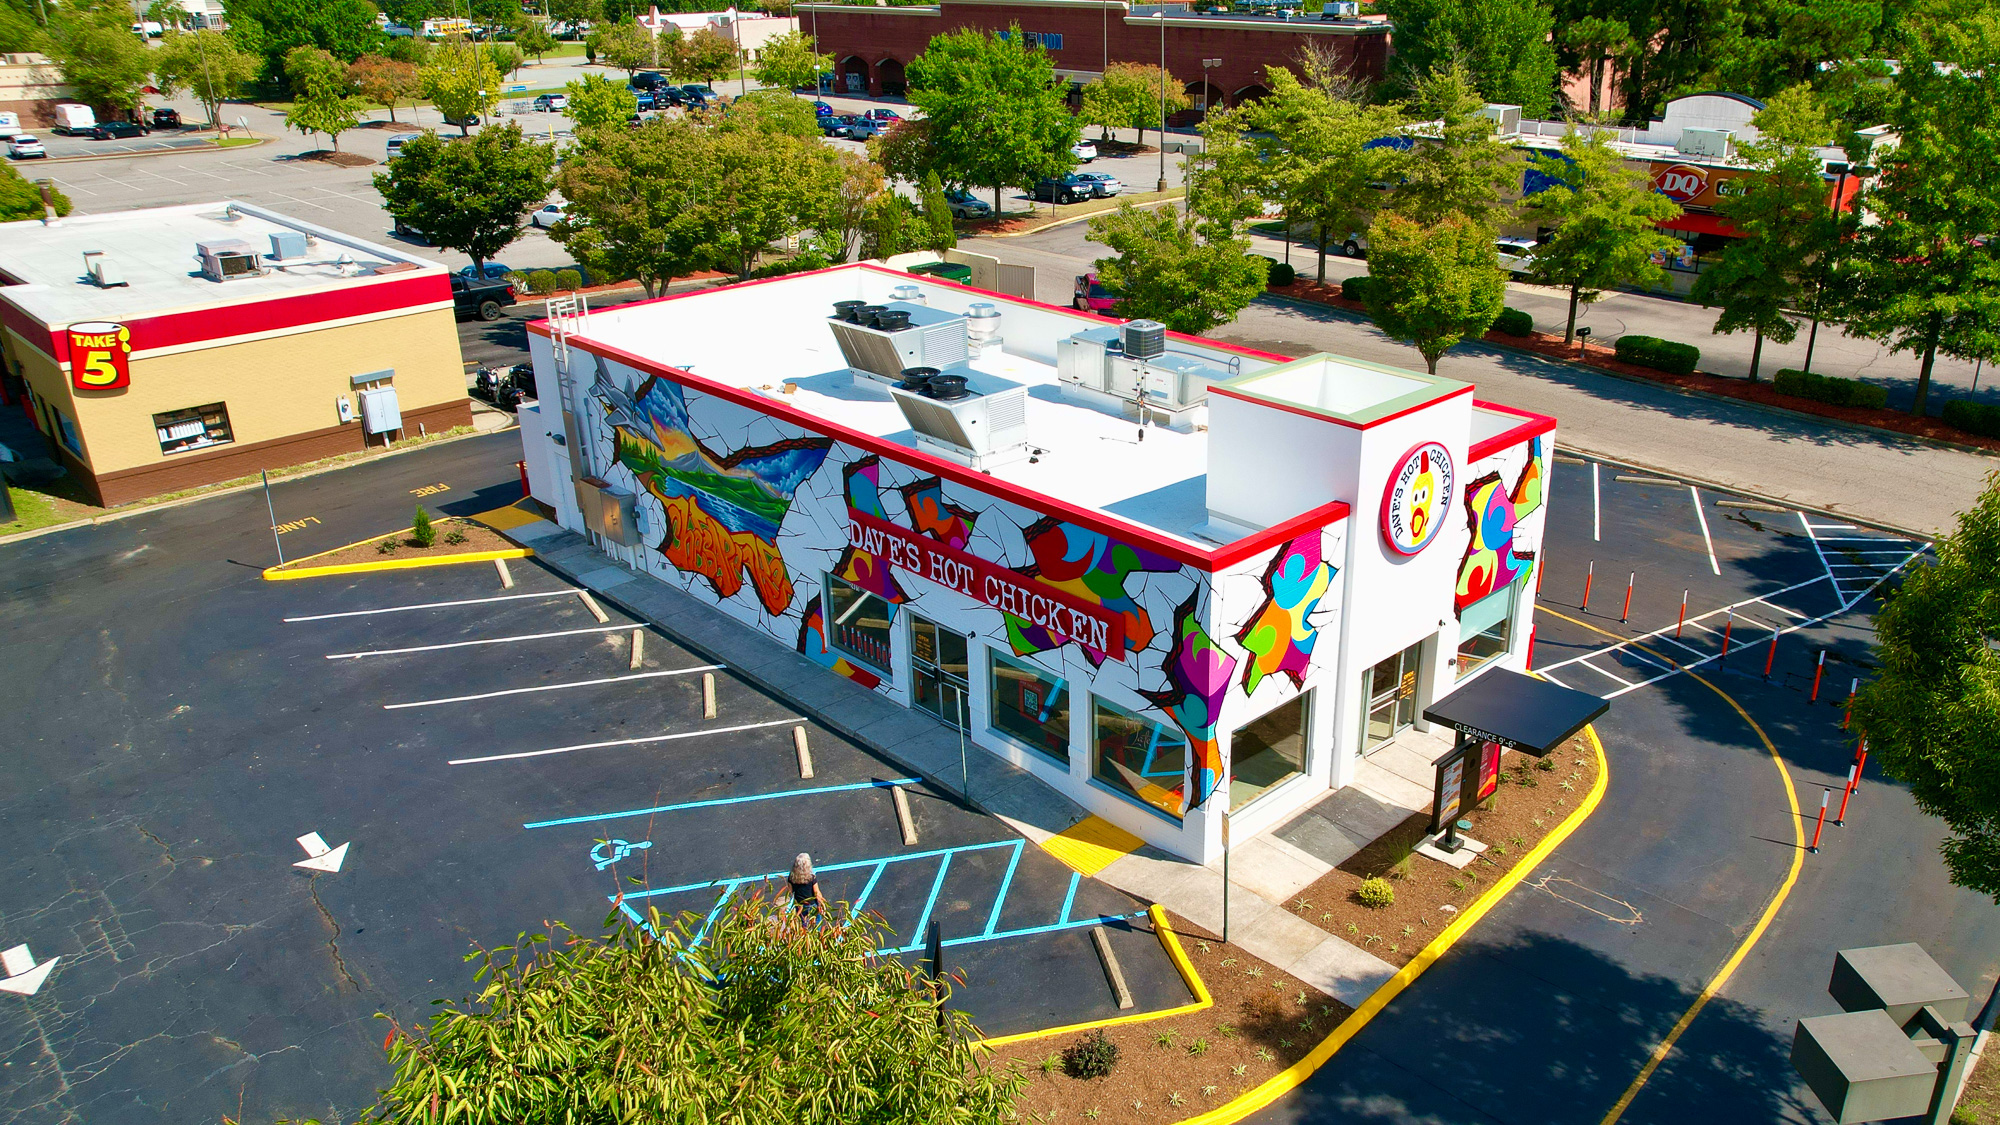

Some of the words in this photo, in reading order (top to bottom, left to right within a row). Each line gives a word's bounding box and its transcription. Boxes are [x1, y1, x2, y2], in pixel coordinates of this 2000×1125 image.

[1663, 173, 1699, 195] DQ
[71, 334, 116, 348] TAKE
[82, 351, 118, 385] 5
[409, 482, 451, 498] FIRE
[1392, 487, 1404, 539] DAVE'S
[1401, 456, 1420, 485] HOT
[1429, 449, 1450, 506] CHICKEN
[270, 516, 321, 535] LANE
[848, 518, 921, 573] DAVE'S
[927, 550, 974, 596] HOT
[985, 575, 1109, 653] CHICKEN
[1454, 722, 1497, 743] CLEARANCE
